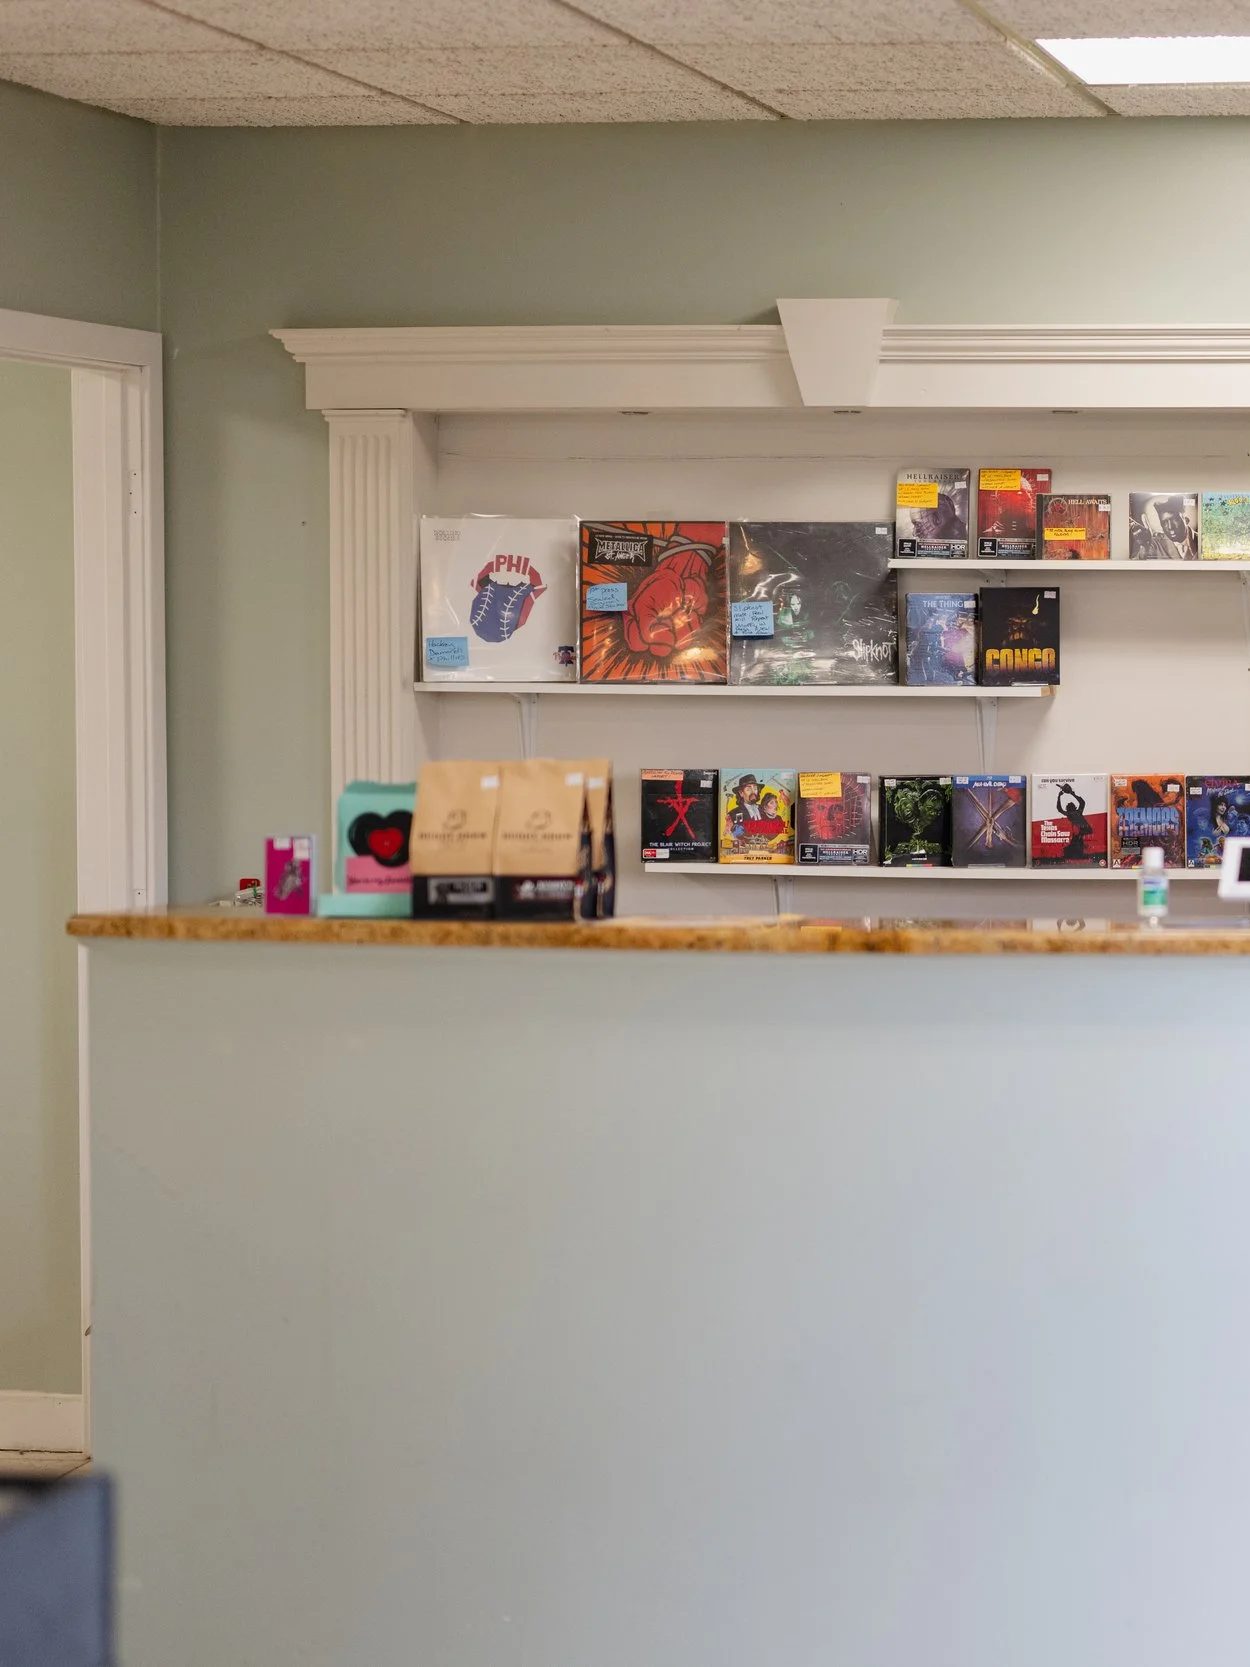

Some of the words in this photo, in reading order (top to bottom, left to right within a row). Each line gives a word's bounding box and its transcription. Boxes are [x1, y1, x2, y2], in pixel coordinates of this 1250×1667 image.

[495, 554, 530, 576] PHI
[923, 600, 937, 608] THE
[940, 600, 964, 608] THING
[985, 648, 1056, 673] CONGO
